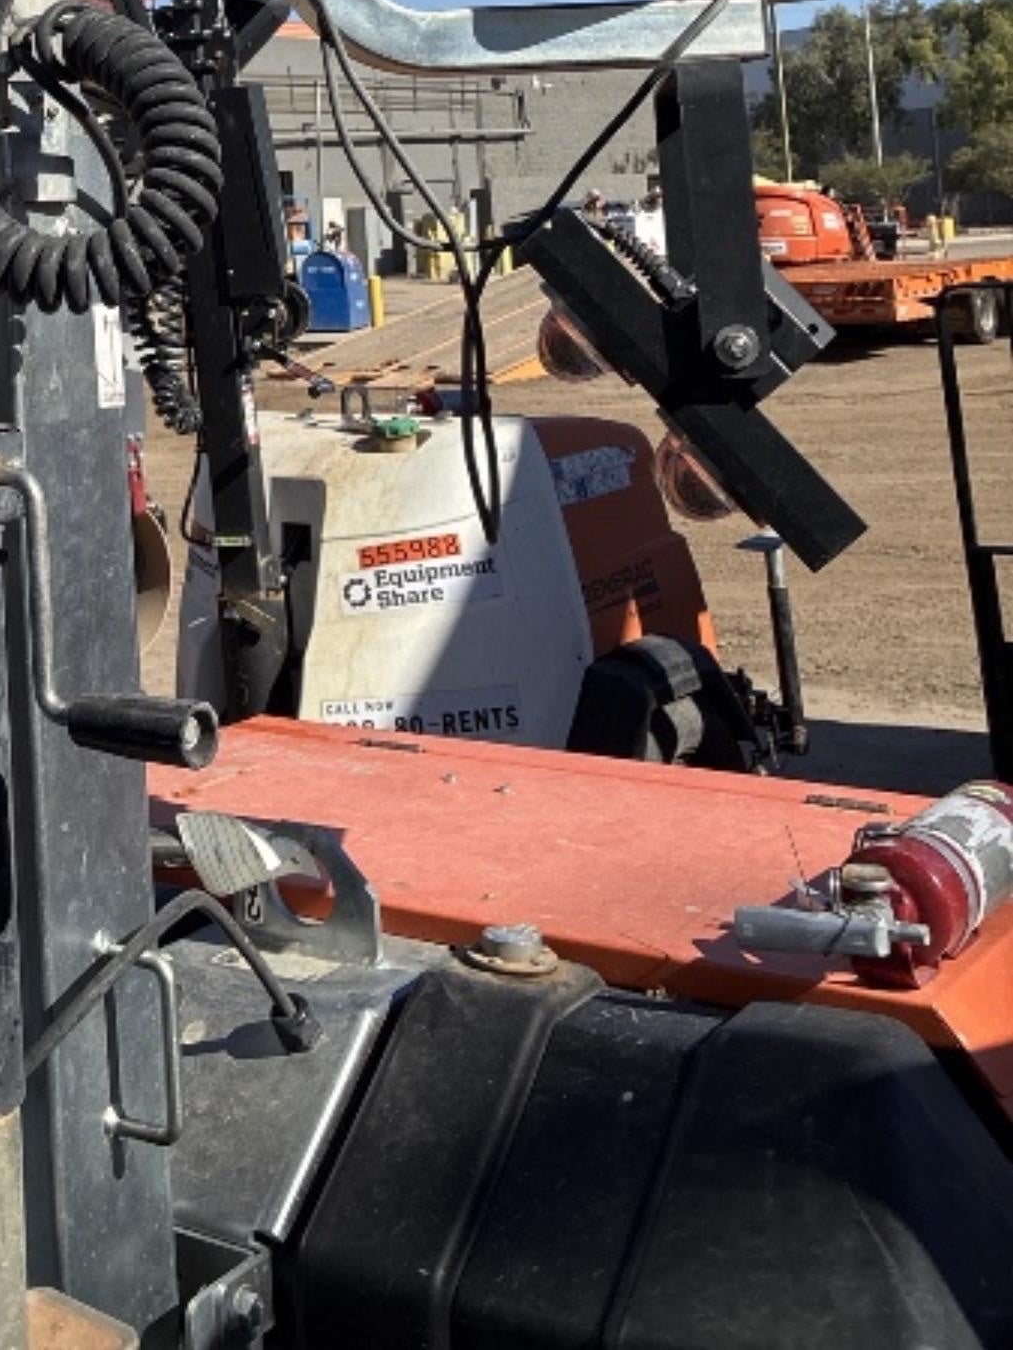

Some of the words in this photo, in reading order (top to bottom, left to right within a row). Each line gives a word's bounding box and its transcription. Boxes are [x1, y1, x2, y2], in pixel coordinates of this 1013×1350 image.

[361, 533, 460, 569] 555988
[373, 557, 497, 588] Equipment
[376, 587, 445, 609] Share
[325, 702, 361, 716] CALL
[364, 700, 395, 713] NOW
